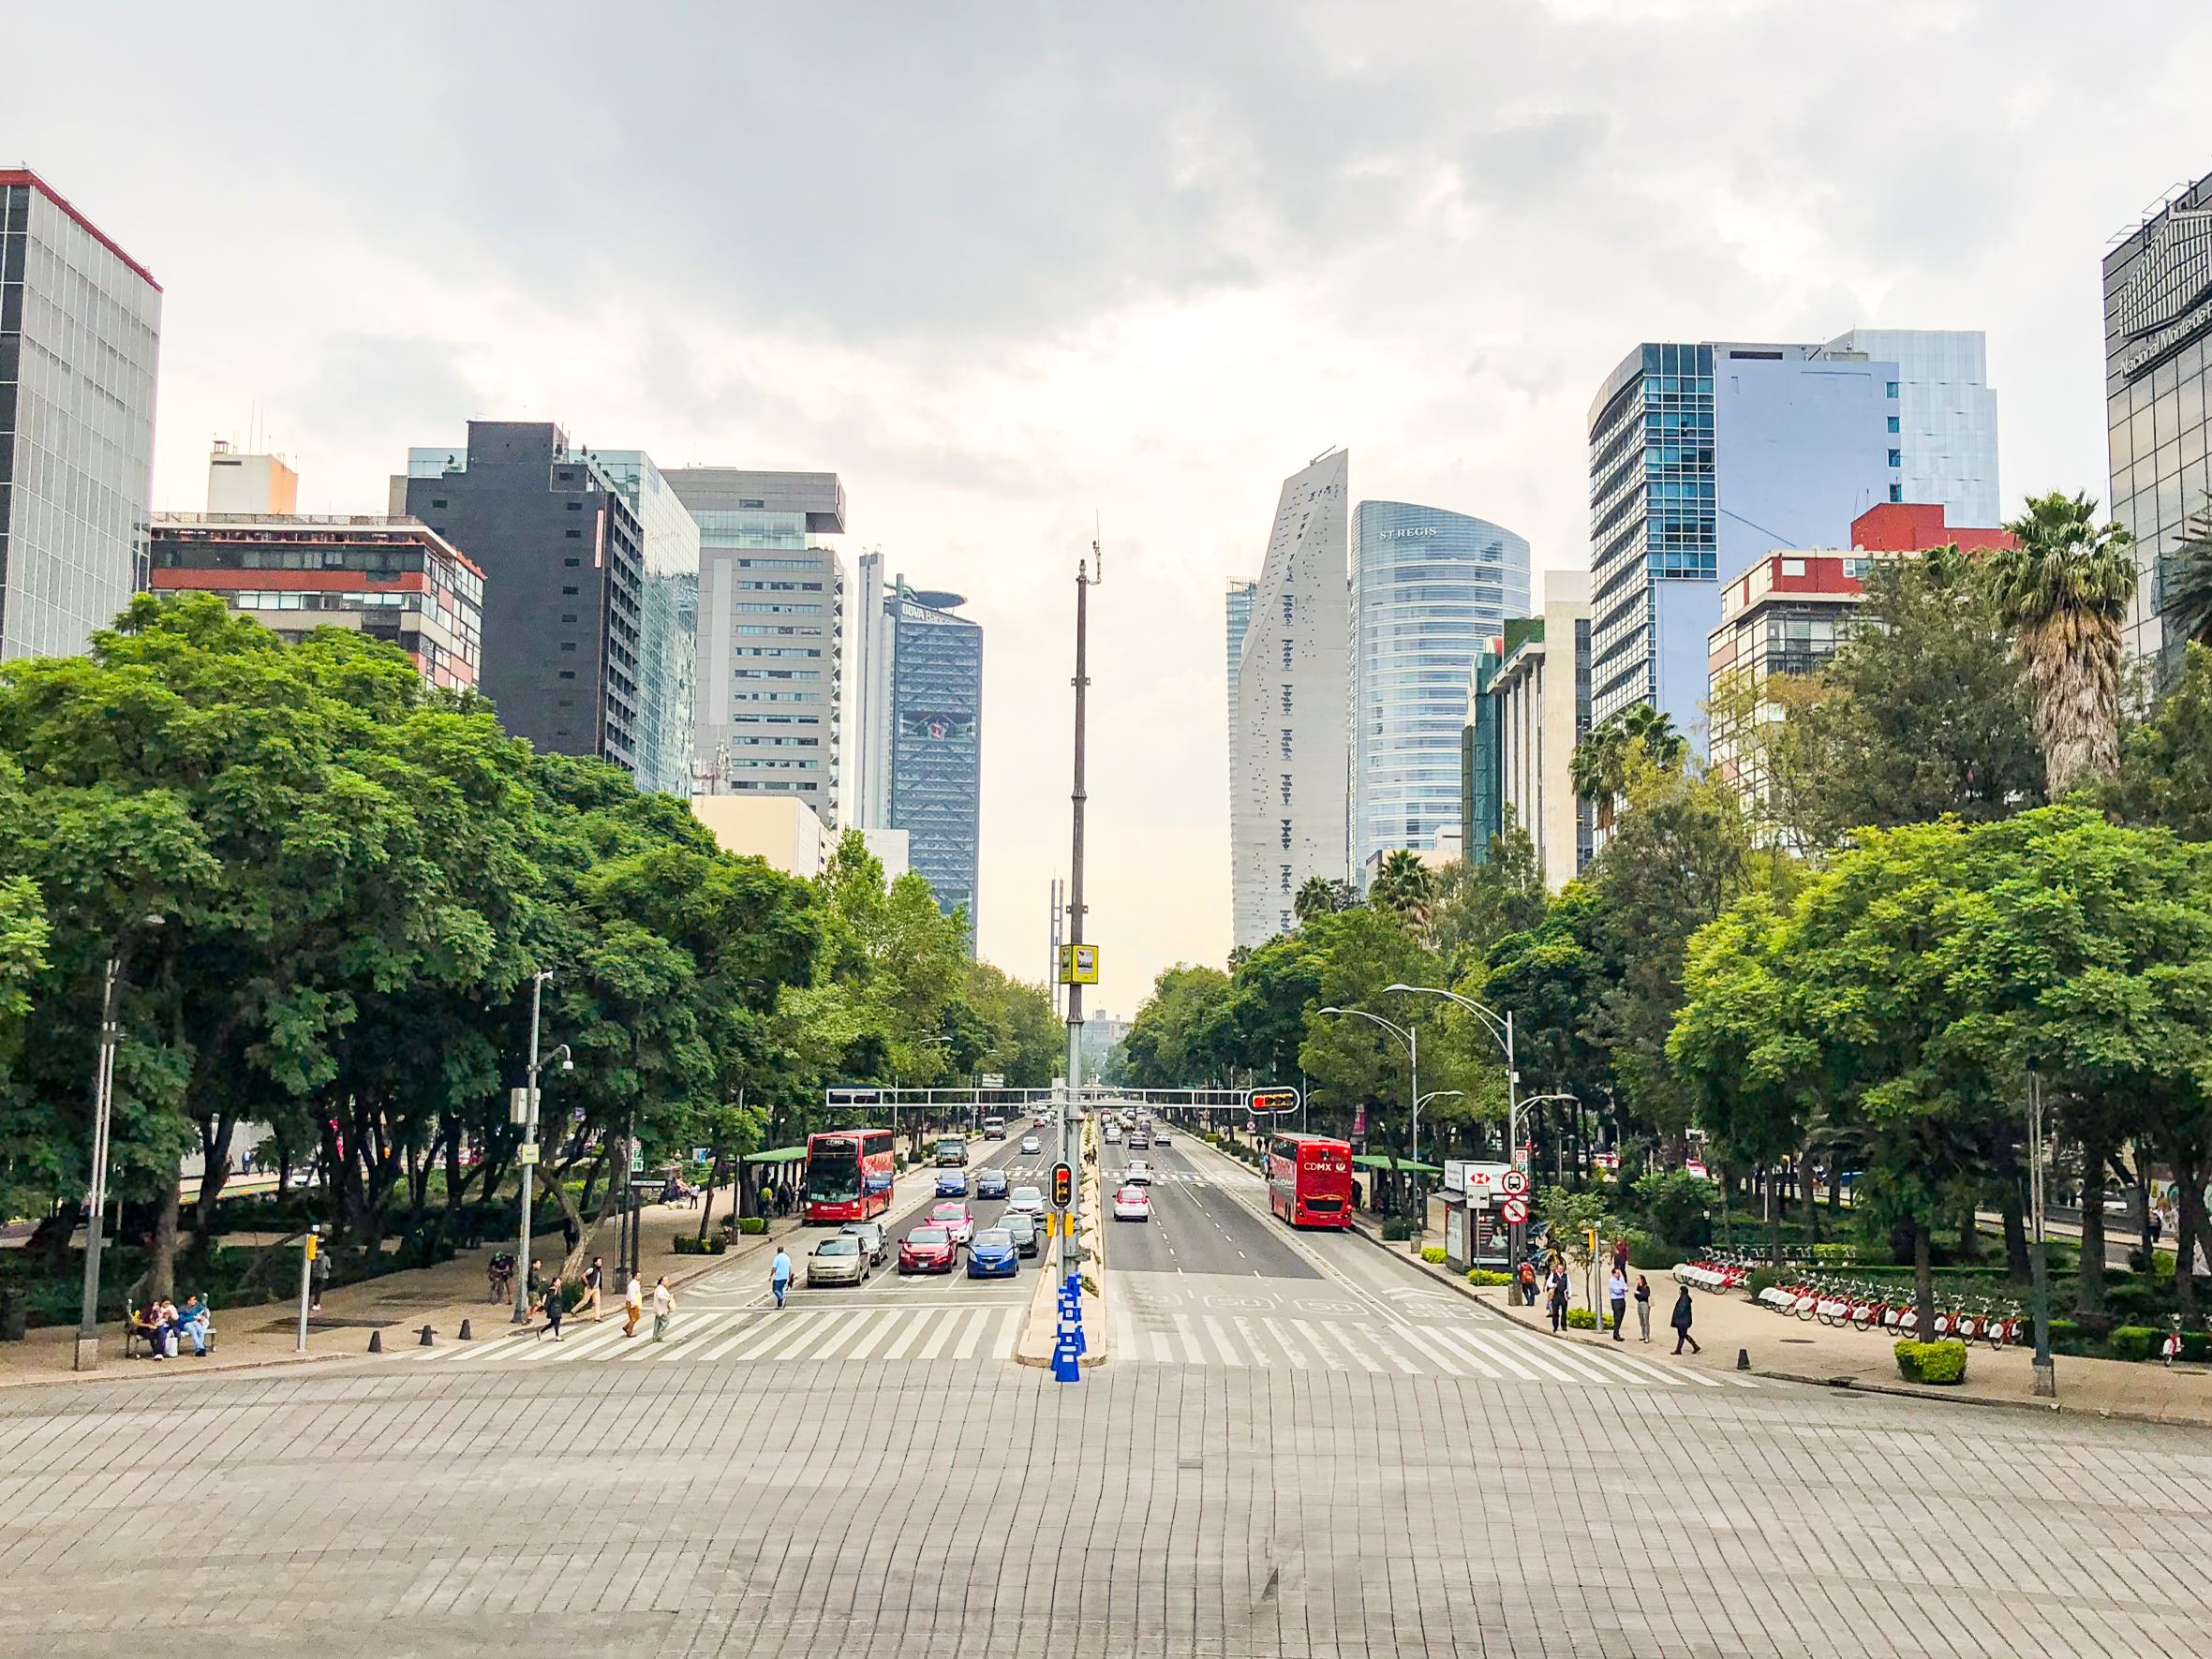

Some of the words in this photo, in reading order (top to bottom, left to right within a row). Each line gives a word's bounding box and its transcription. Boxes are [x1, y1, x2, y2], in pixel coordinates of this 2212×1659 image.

[2120, 336, 2160, 377] Nacional
[2160, 319, 2191, 350] Monte
[2192, 309, 2206, 329] de
[1397, 526, 1437, 537] REGIS
[901, 602, 925, 620] BBVA
[1303, 1163, 1331, 1171] CDMX
[1308, 1302, 1354, 1311] 50
[1404, 1302, 1472, 1312] BUS
[1405, 1309, 1494, 1321] SOLO
